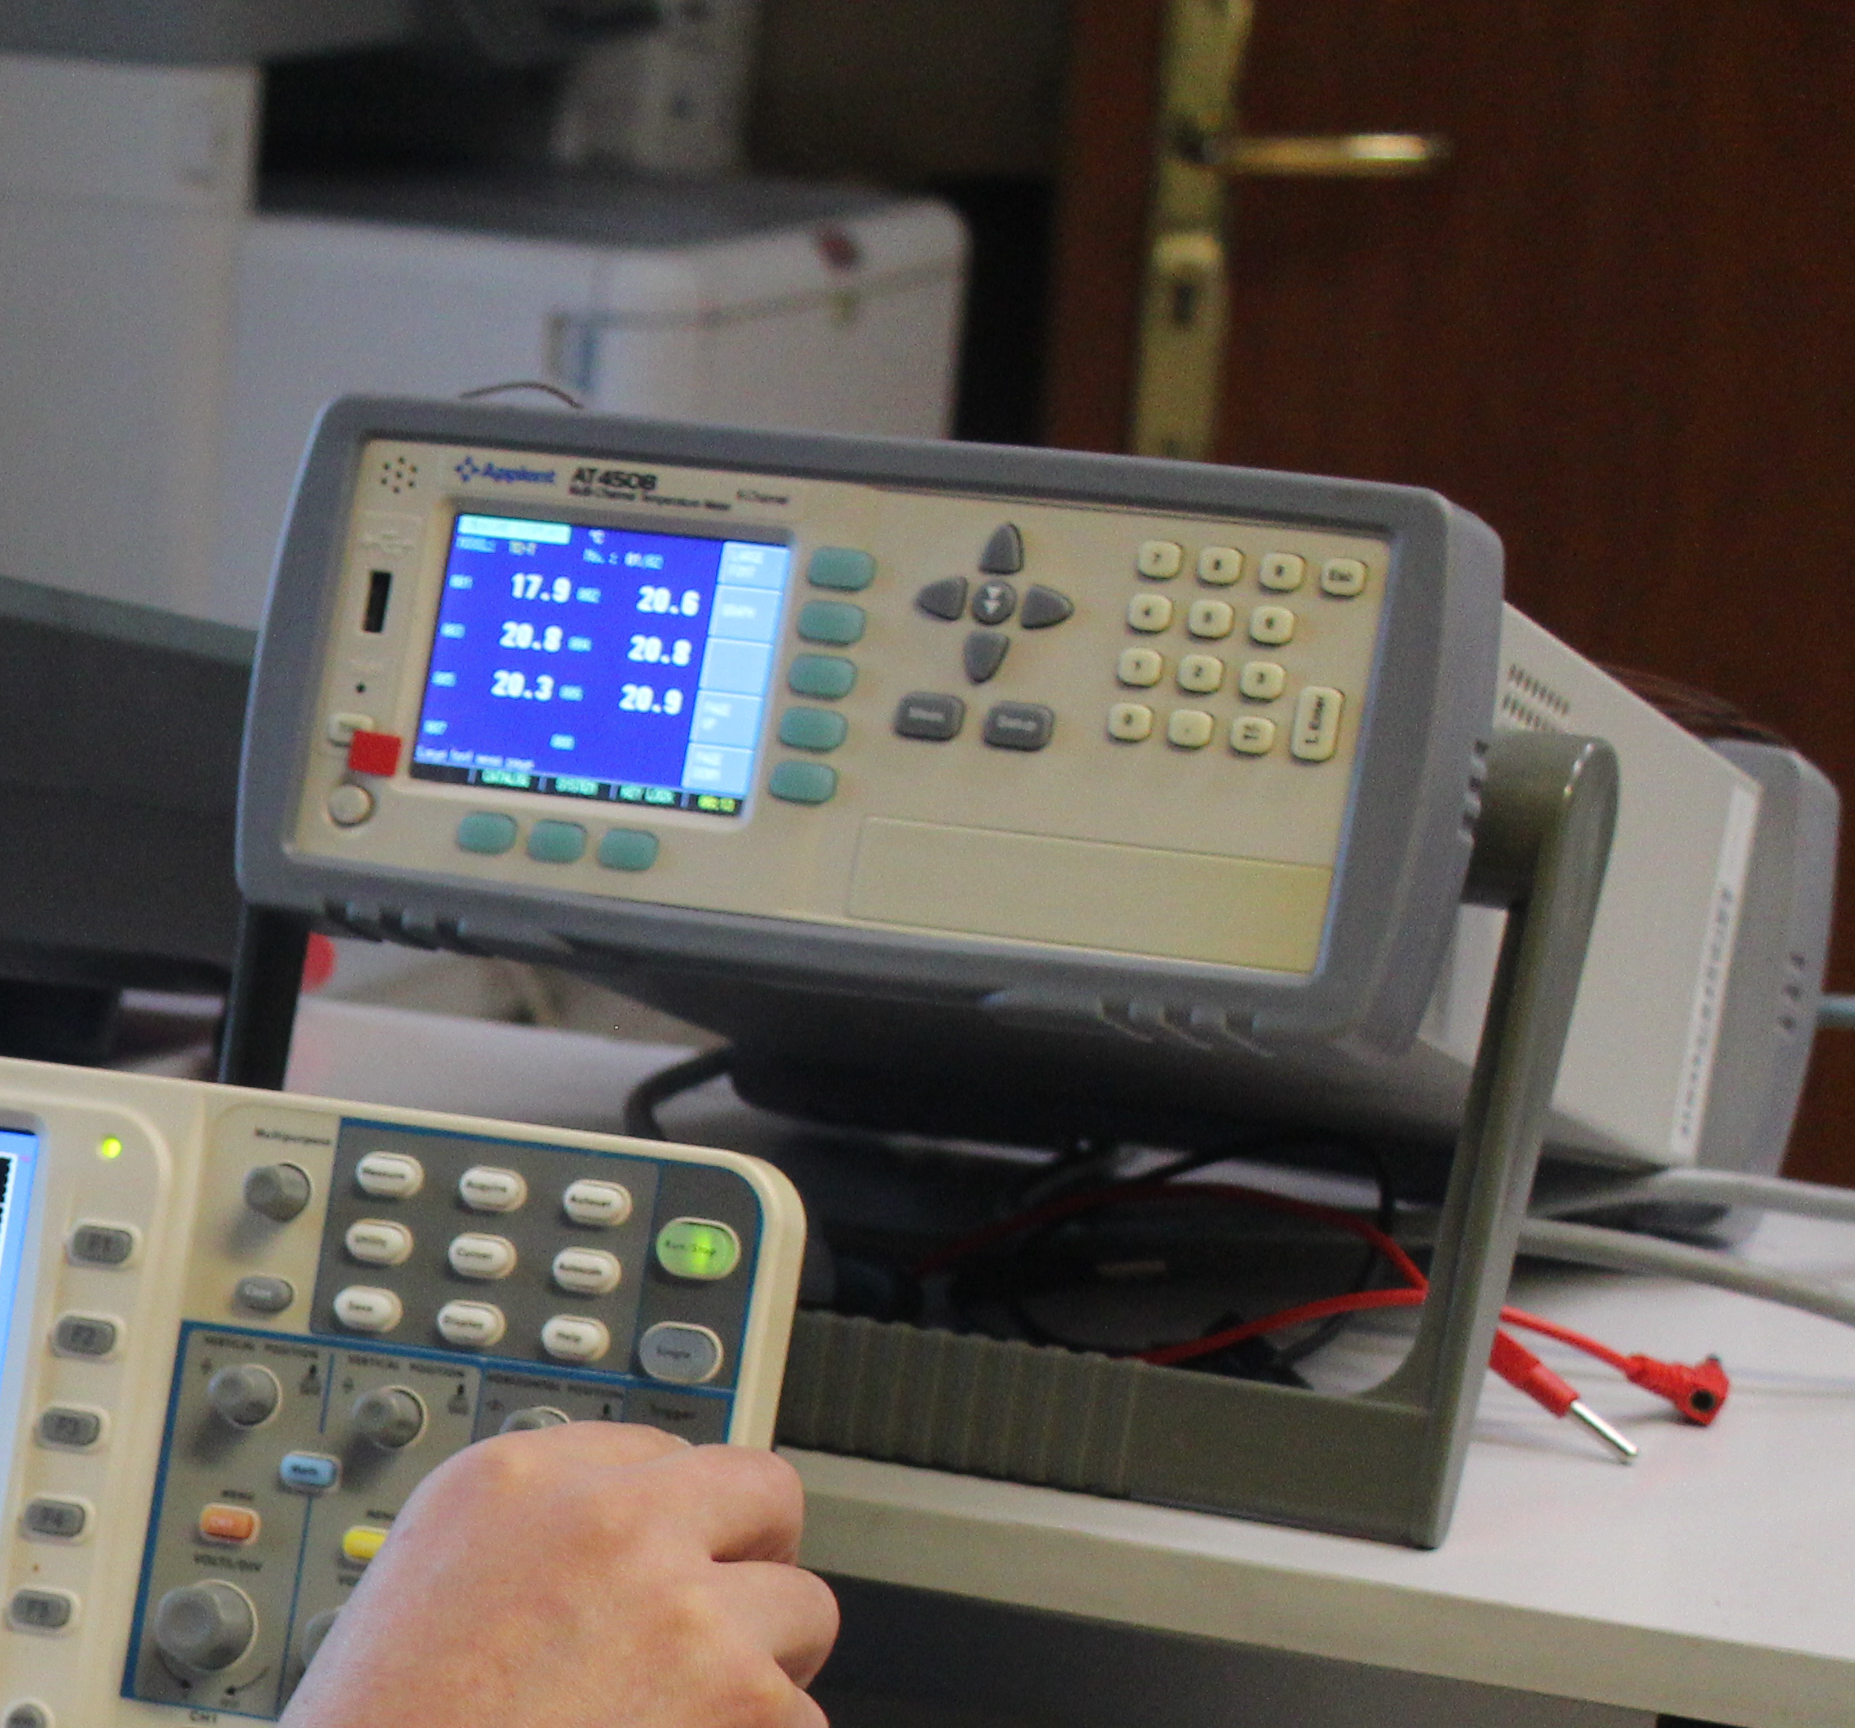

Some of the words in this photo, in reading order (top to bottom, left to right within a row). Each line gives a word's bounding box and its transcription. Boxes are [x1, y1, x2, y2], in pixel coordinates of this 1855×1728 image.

[510, 571, 572, 604] 17.9
[635, 584, 701, 617] 20.6
[498, 620, 564, 653] 20.8
[626, 633, 693, 667] 20.8
[489, 668, 555, 702] 20.3
[617, 682, 684, 716] 20.9
